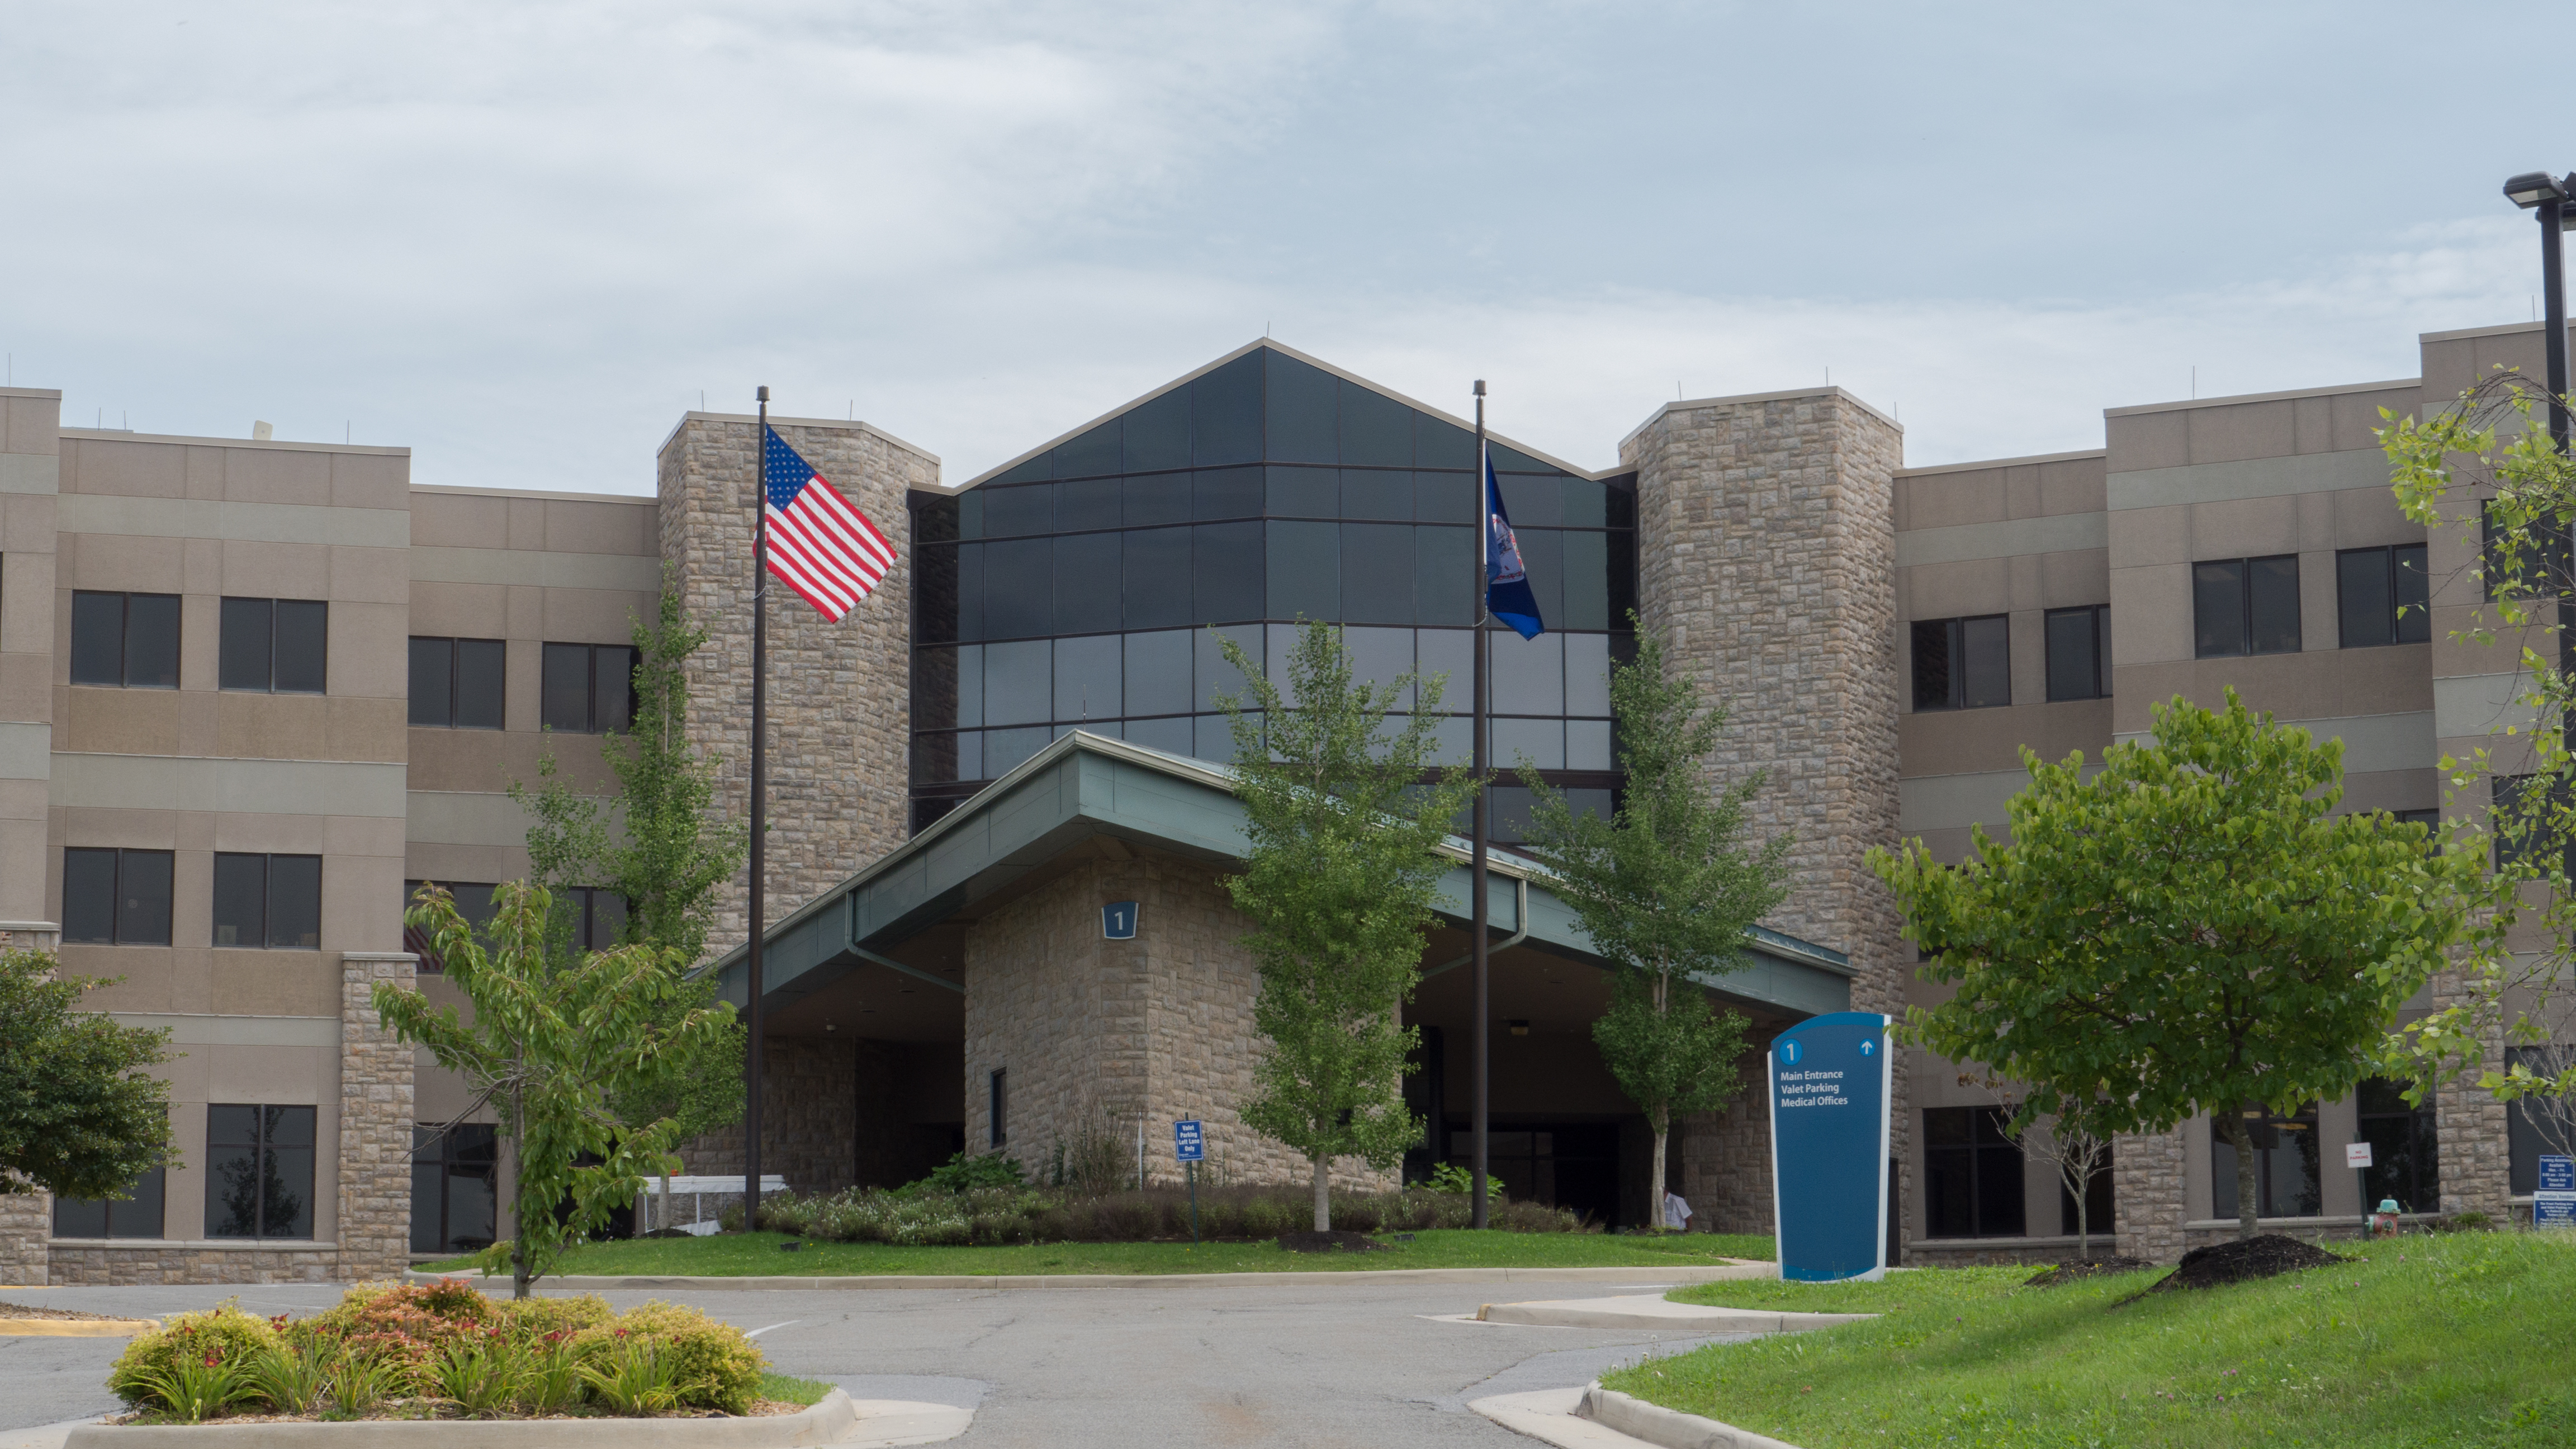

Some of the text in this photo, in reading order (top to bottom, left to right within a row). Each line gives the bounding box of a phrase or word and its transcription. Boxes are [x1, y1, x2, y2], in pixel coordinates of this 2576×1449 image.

[1115, 911, 1123, 930] 1
[1787, 1043, 1794, 1061] 1
[1781, 1071, 1844, 1081] Main Entrance
[1781, 1083, 1839, 1094] Valet Parking
[1781, 1096, 1848, 1107] Medical Offices
